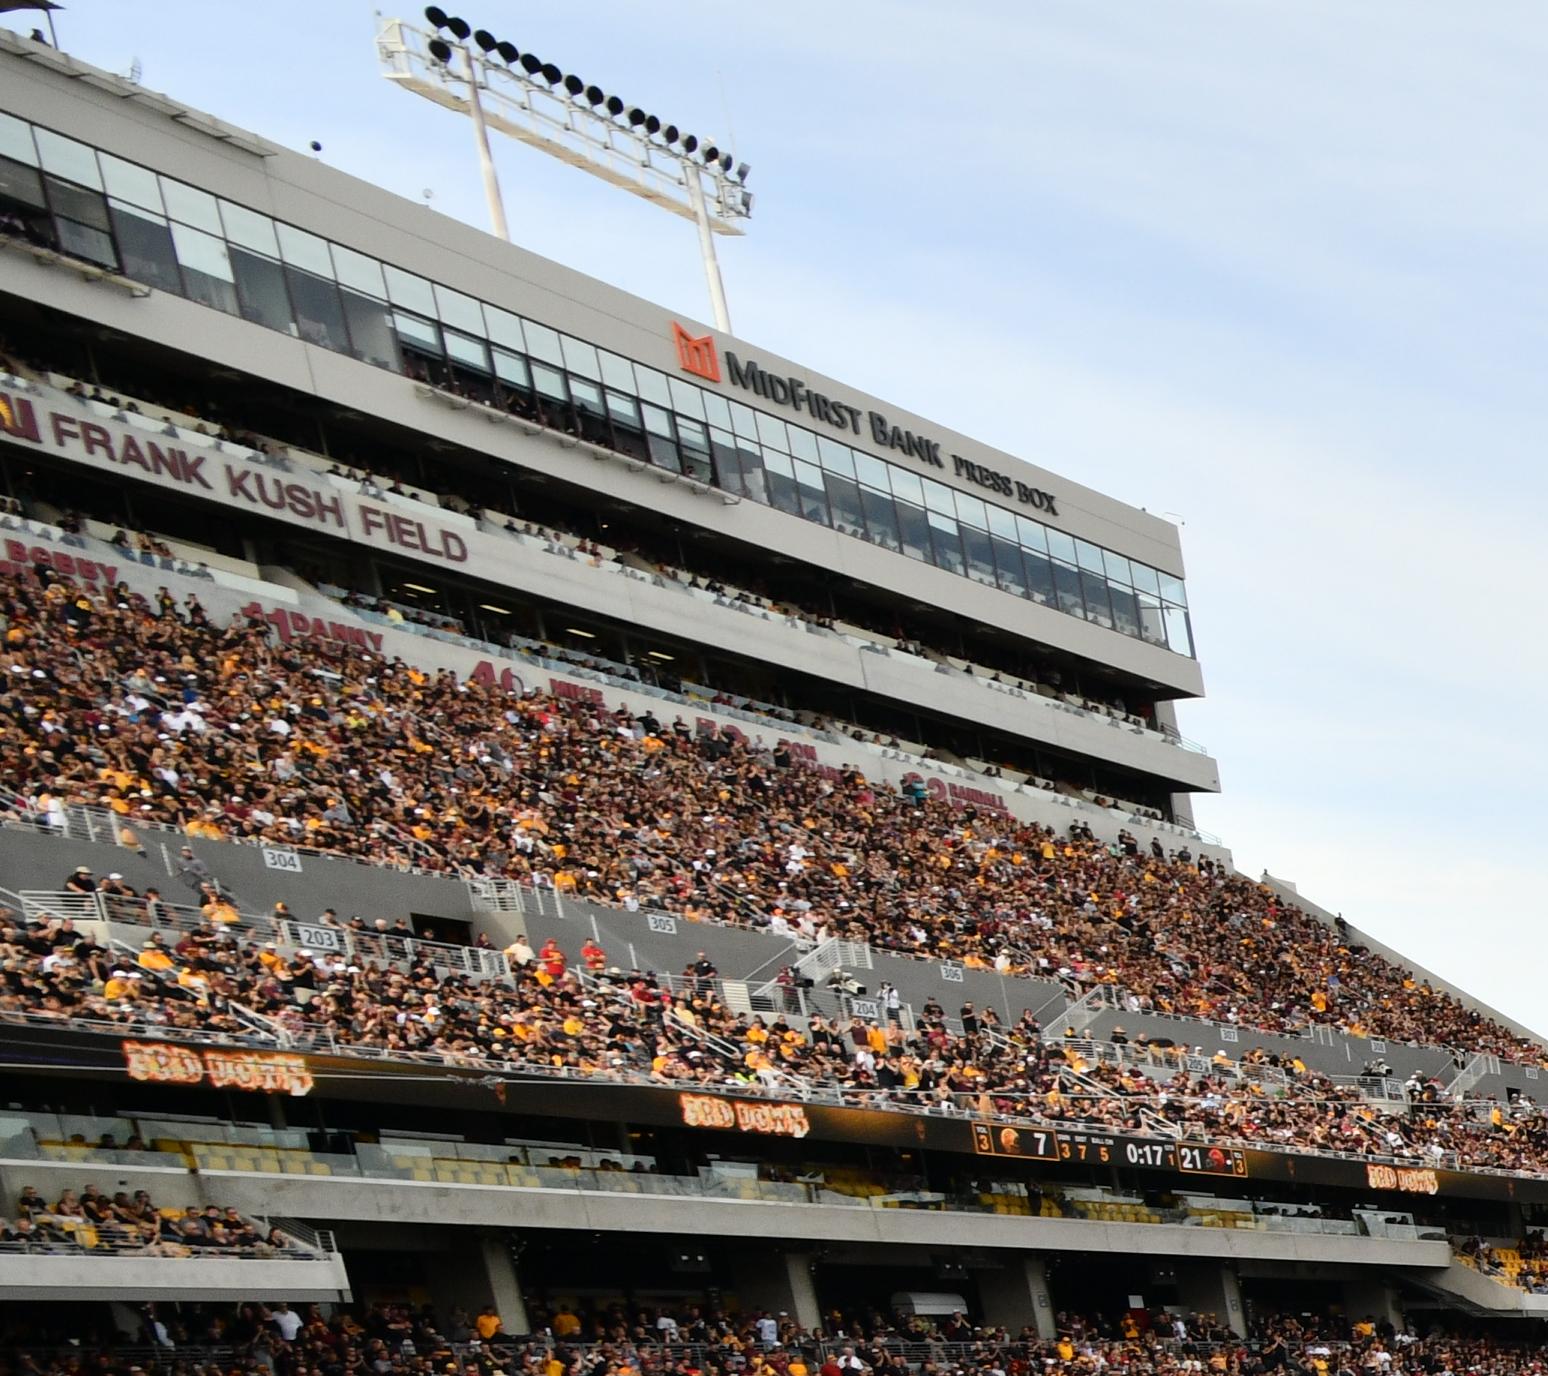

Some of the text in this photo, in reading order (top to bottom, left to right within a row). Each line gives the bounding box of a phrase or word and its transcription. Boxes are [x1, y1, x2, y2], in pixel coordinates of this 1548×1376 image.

[49, 412, 214, 491] FRANK
[225, 464, 345, 527] KUSH
[360, 506, 468, 563] FIELD
[952, 455, 1013, 497] PRESS
[1015, 481, 1059, 516] BOX
[5, 538, 118, 585] BOBBY
[267, 851, 296, 869] 304
[652, 917, 673, 932] 305
[303, 928, 334, 947] 203
[943, 967, 961, 980] 306
[856, 1002, 875, 1016] 204
[979, 1135, 989, 1150] 3
[1033, 1132, 1046, 1155] 7
[1061, 1143, 1109, 1162] 3 7 5
[1127, 1143, 1163, 1166] 0:17
[1181, 1148, 1201, 1170] 21
